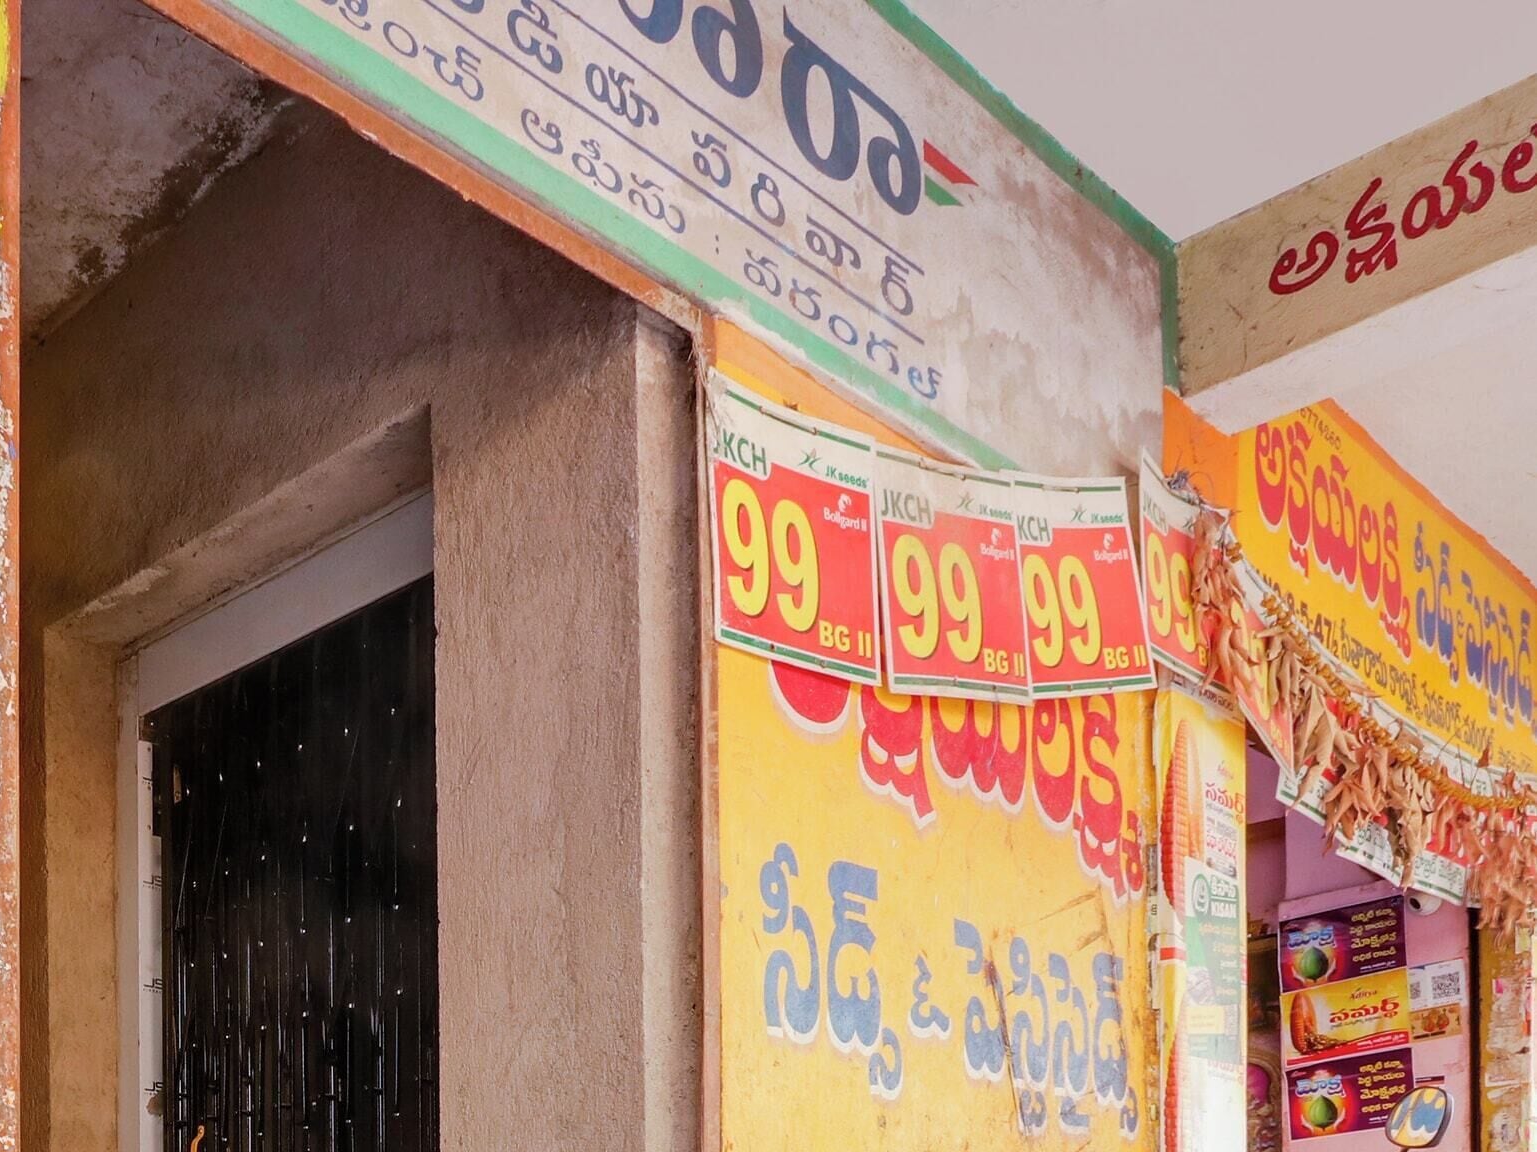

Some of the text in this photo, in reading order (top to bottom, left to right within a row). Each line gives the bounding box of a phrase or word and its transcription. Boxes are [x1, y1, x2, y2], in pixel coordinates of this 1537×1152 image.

[1268, 122, 1537, 296] అక్షయల
[743, 247, 944, 400] వరంగల్
[838, 472, 868, 489] seeds
[823, 506, 861, 530] Bollgard
[881, 488, 933, 525] JKCH
[1016, 514, 1051, 543] KCH
[722, 478, 820, 632] 99
[891, 533, 983, 664] 99
[1022, 553, 1102, 668] 99
[1147, 531, 1196, 653] 99
[819, 616, 872, 659] BG II
[1103, 643, 1147, 670] BG II
[983, 646, 1025, 677] BG II
